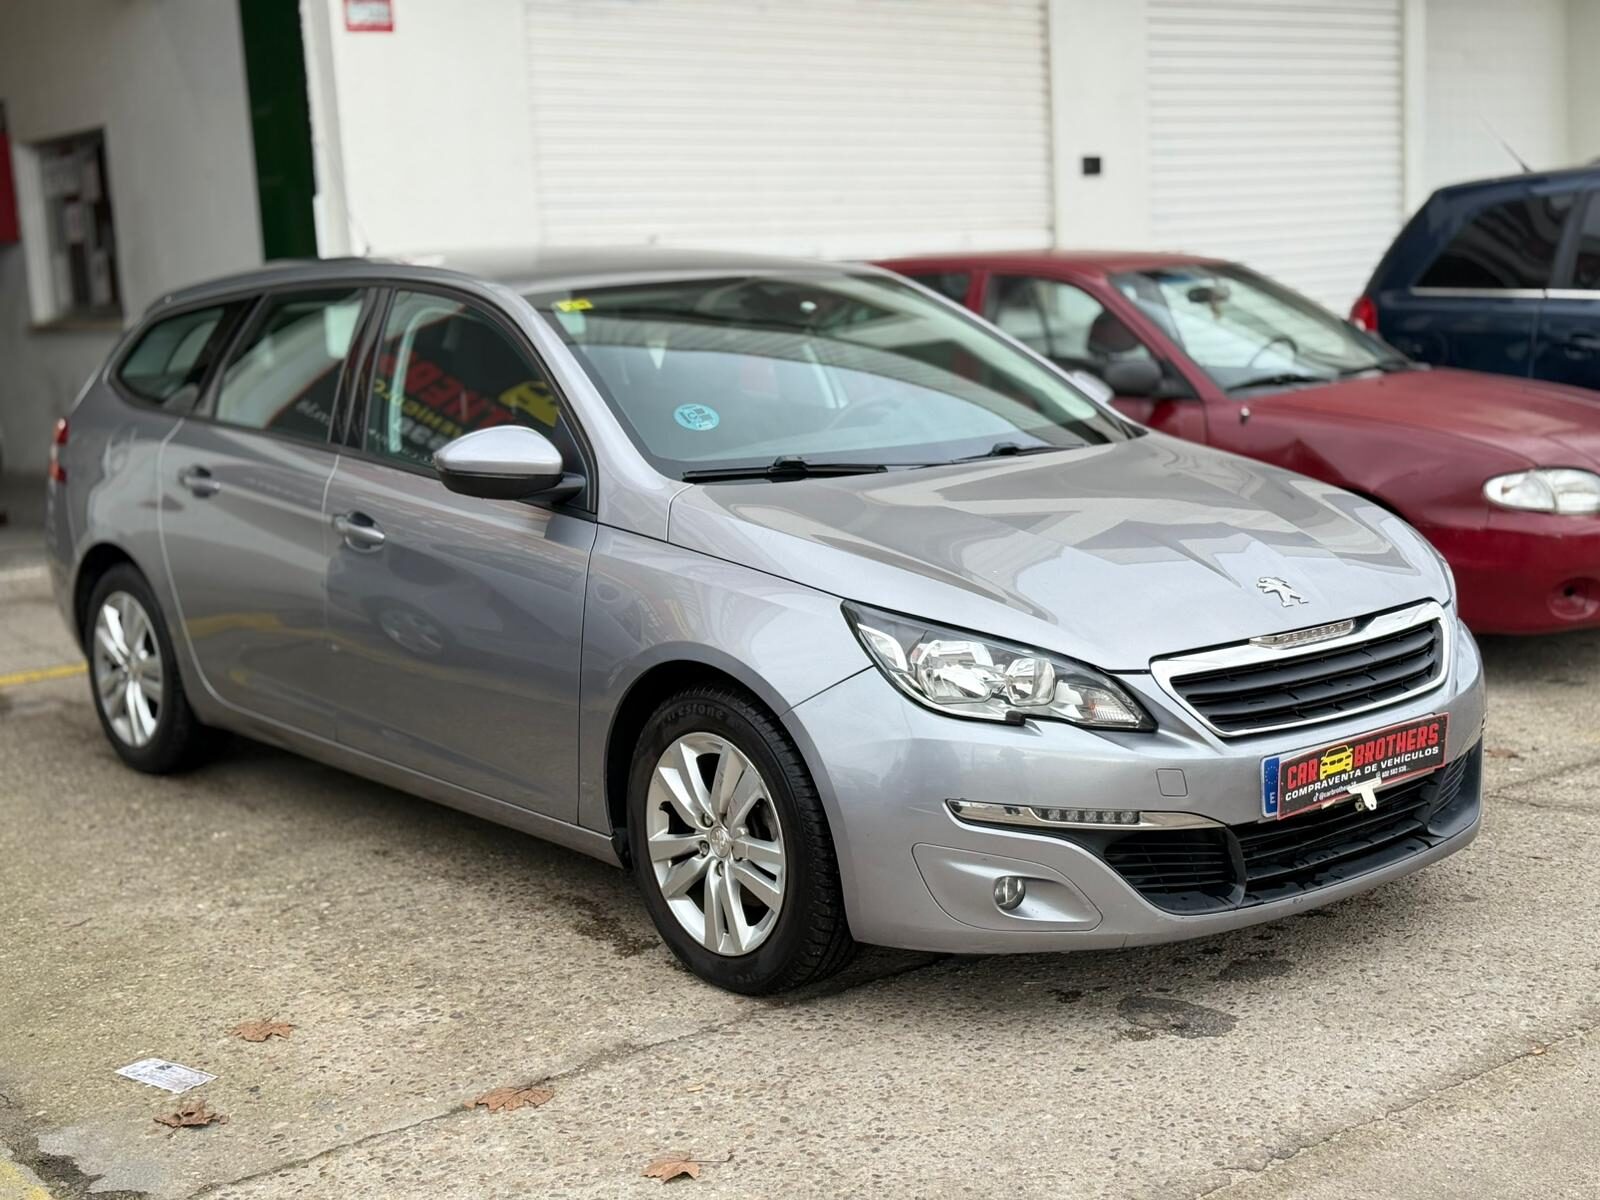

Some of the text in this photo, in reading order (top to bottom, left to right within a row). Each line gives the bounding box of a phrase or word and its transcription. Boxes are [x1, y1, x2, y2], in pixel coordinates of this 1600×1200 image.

[1285, 746, 1439, 801] COMPRAVENTA DE VEHÍCULOS
[1287, 723, 1440, 790] CAR BROTHERS
[1269, 791, 1276, 804] E
